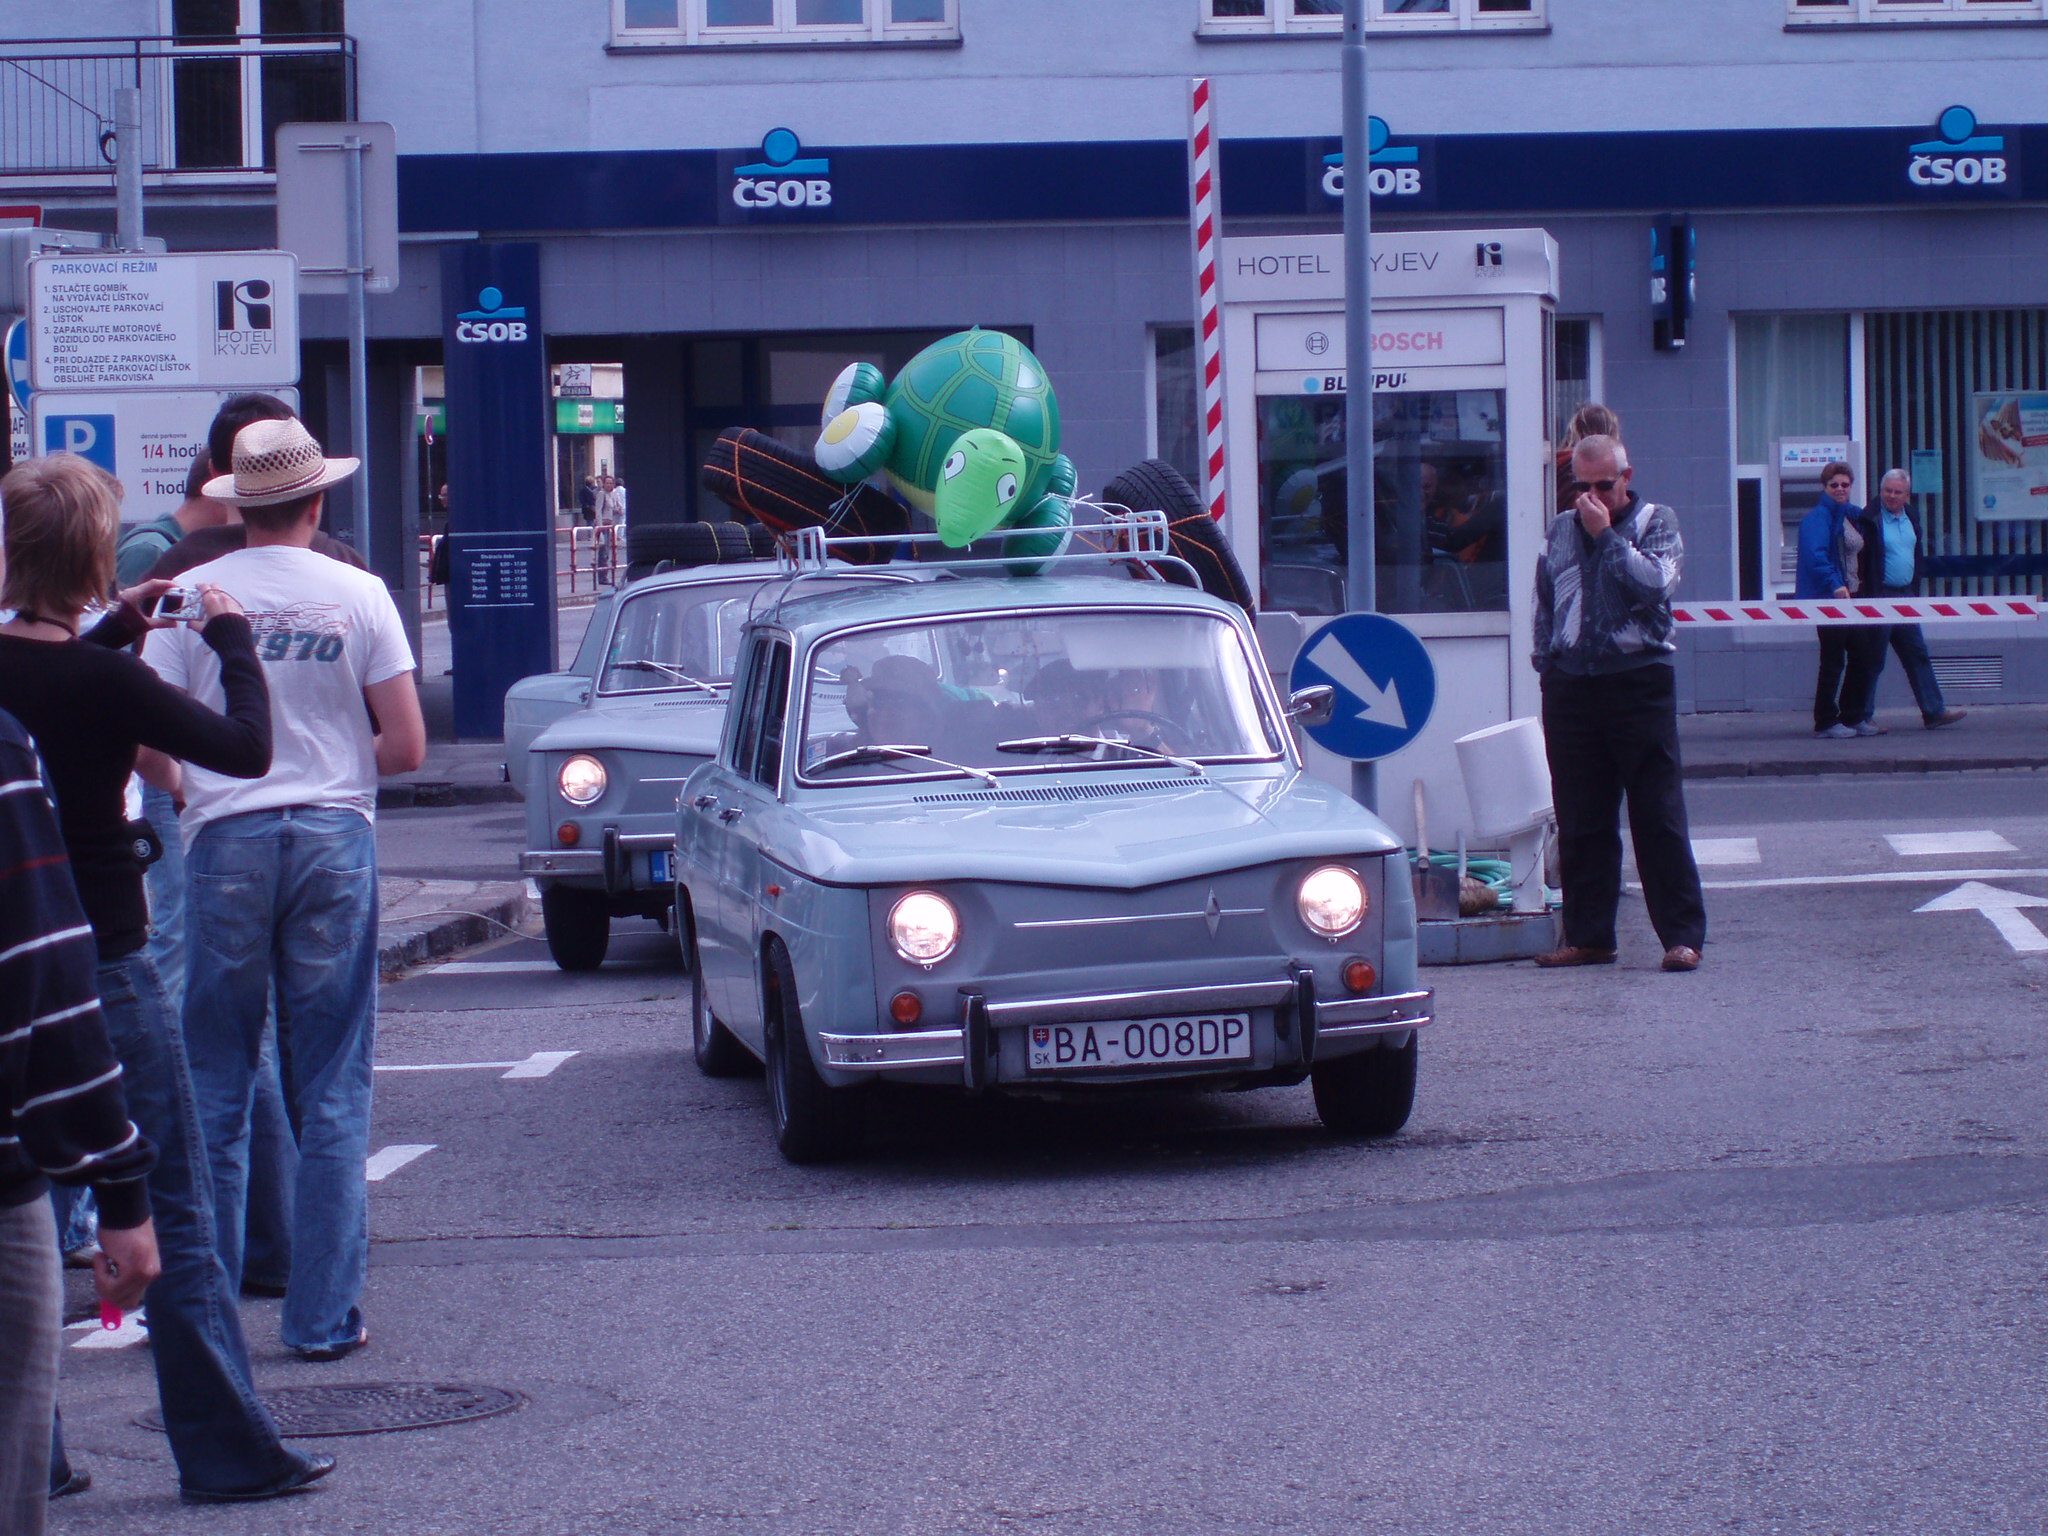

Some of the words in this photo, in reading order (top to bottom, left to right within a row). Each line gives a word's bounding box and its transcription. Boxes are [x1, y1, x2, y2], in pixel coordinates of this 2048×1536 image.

[1908, 155, 2007, 185] ČSOB
[1322, 165, 1421, 196] ČOB
[733, 178, 832, 208] ČSOB
[52, 261, 118, 274] PARKOVACÍ
[122, 260, 158, 273] REŽIM
[1238, 255, 1330, 276] HOTEL
[1370, 252, 1439, 271] YJEV
[52, 284, 91, 293] STLAČTE
[93, 282, 128, 292] GOMBÍK
[67, 292, 110, 302] VYDÁVAČI
[112, 291, 149, 301] LÍSTKOV
[53, 305, 110, 313] USCHOVAJTE
[113, 302, 164, 312] PARKOVACÍ
[52, 313, 84, 323] LÍSTOK
[53, 326, 110, 334] ZAPARKUJTE
[112, 323, 162, 333] MOTOROVÉ
[456, 321, 528, 342] ČSOB
[53, 335, 90, 343] VOZIDLO
[108, 333, 177, 342] PARKOVACIEHO
[217, 331, 272, 343] HOTEL
[53, 345, 78, 353] BOXU
[217, 343, 272, 355] KYJEV
[53, 356, 68, 364] PRI
[70, 356, 110, 364] ODJAZDE
[112, 355, 119, 363] Z
[121, 354, 177, 363] PARKOVISKA
[53, 363, 105, 373] PREDLOŽTE
[108, 362, 158, 372] PARKOVACÍ
[160, 360, 191, 372] LÍSTOK
[53, 375, 96, 383] OBSLUHE
[98, 373, 155, 382] PARKOVISKA
[65, 420, 97, 453] P
[142, 444, 164, 459] 1/4
[168, 443, 202, 458] hodi
[143, 481, 150, 495] 1
[156, 480, 186, 495] hod
[1055, 1018, 1244, 1063] BA-008DP
[1034, 1053, 1050, 1065] SK
